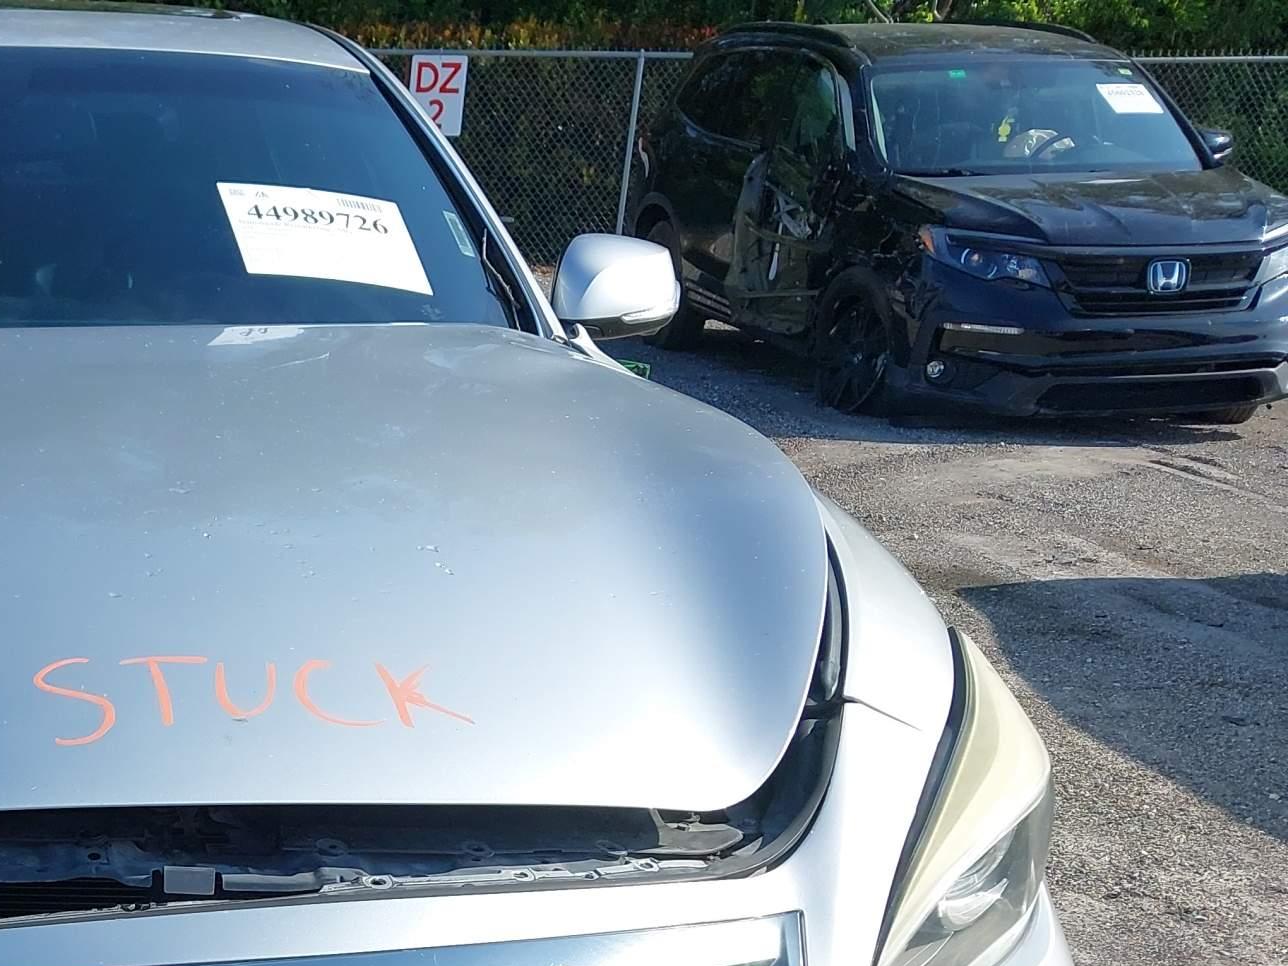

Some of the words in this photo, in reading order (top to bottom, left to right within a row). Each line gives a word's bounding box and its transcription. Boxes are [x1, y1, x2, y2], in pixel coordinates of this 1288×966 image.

[416, 62, 461, 93] DZ
[429, 99, 444, 129] 2
[247, 204, 389, 234] 44989726
[33, 656, 475, 746] STUCK
